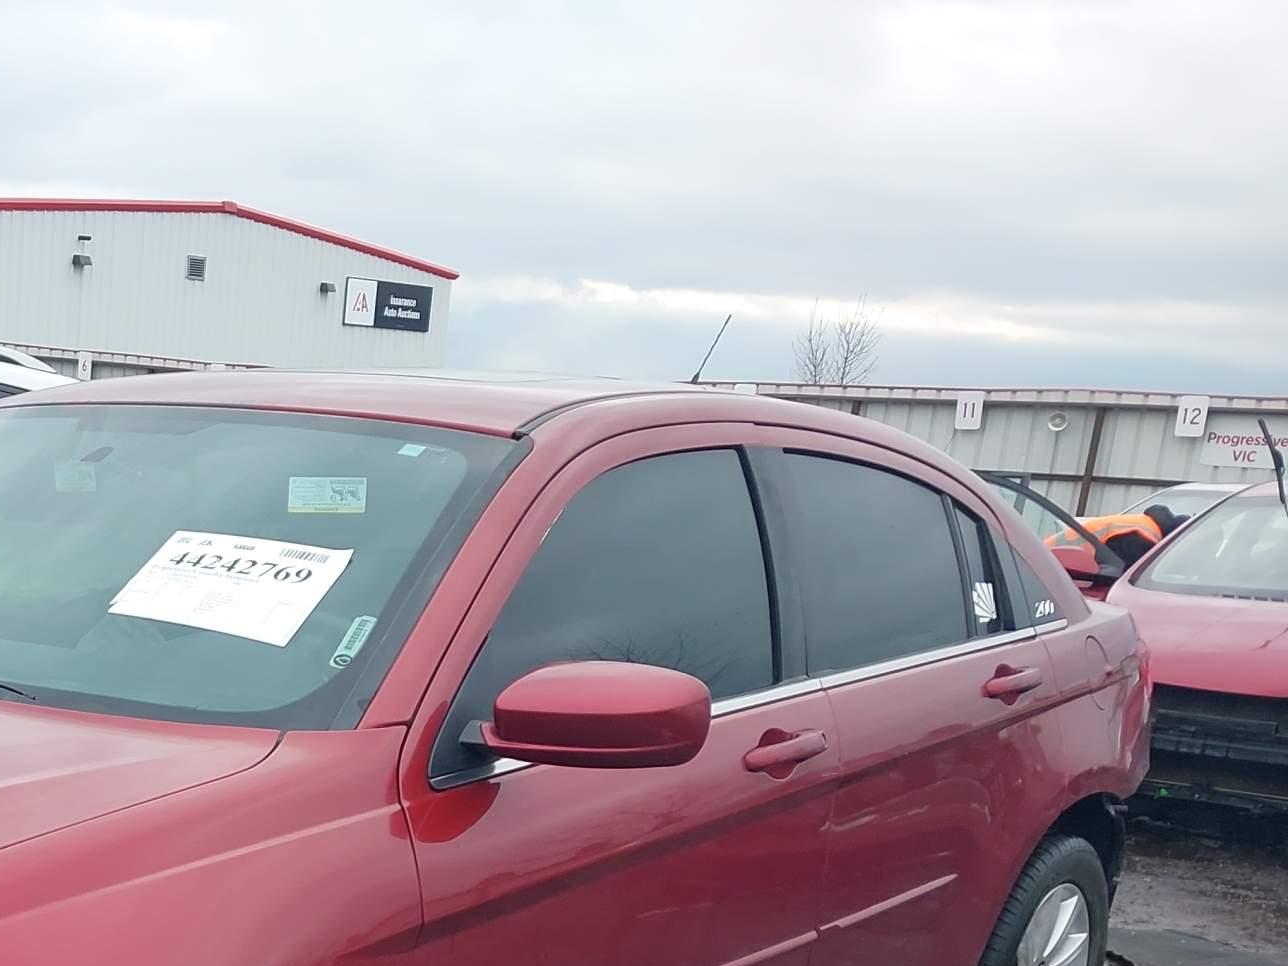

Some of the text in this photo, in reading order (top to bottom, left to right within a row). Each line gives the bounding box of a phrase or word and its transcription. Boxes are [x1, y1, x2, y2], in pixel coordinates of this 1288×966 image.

[390, 294, 416, 307] Insurance
[384, 306, 420, 319] Auto Auctions
[82, 359, 88, 371] 6
[962, 402, 976, 419] 11
[1182, 407, 1202, 425] 12
[1207, 431, 1288, 448] Progressve
[1232, 450, 1257, 463] VIC
[168, 551, 313, 584] 44242769
